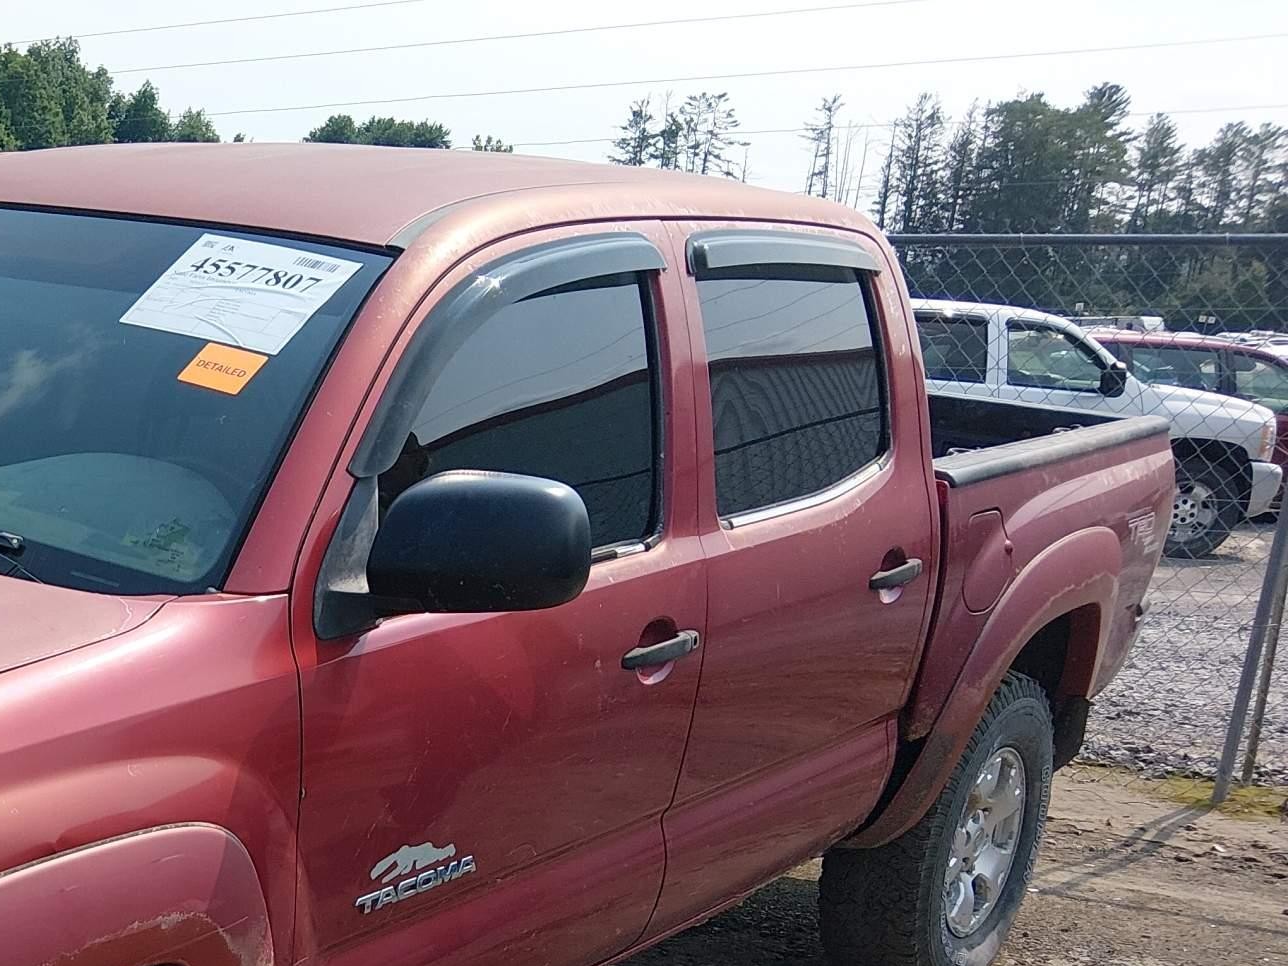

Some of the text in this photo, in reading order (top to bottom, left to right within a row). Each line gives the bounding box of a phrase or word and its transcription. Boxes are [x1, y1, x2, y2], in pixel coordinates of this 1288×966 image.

[190, 256, 324, 294] 45577807
[196, 358, 247, 378] DETAILED
[355, 854, 477, 914] TACOMA
